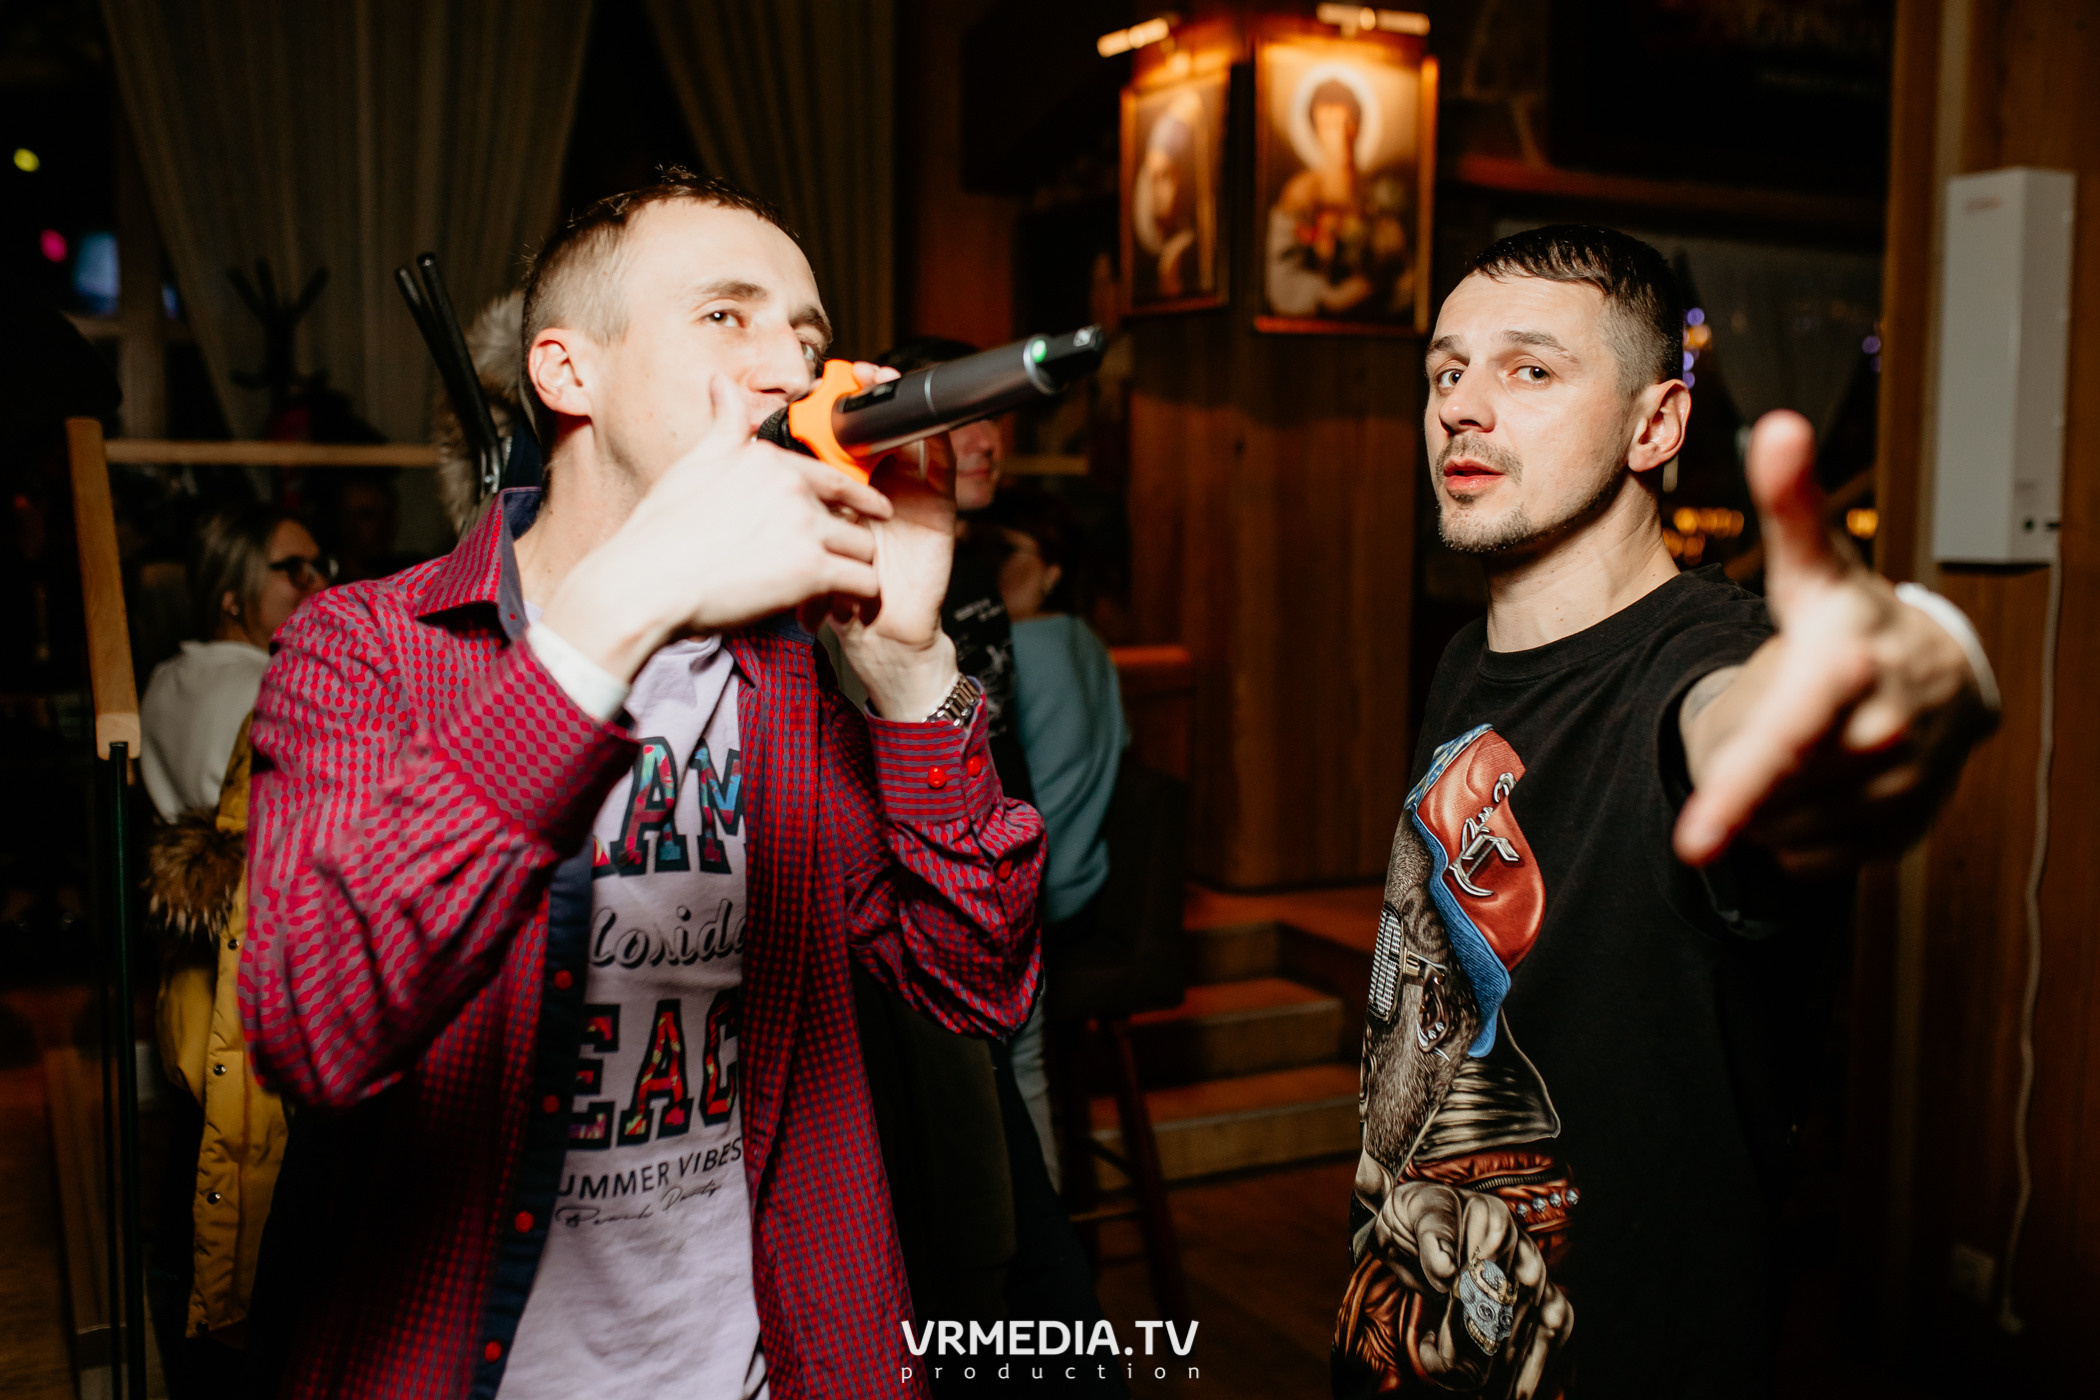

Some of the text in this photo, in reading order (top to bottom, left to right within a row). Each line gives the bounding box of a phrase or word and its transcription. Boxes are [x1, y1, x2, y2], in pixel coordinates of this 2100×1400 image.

[590, 898, 746, 969] lorid
[568, 986, 740, 1150] EAC
[557, 1137, 742, 1199] UMMER VIBES
